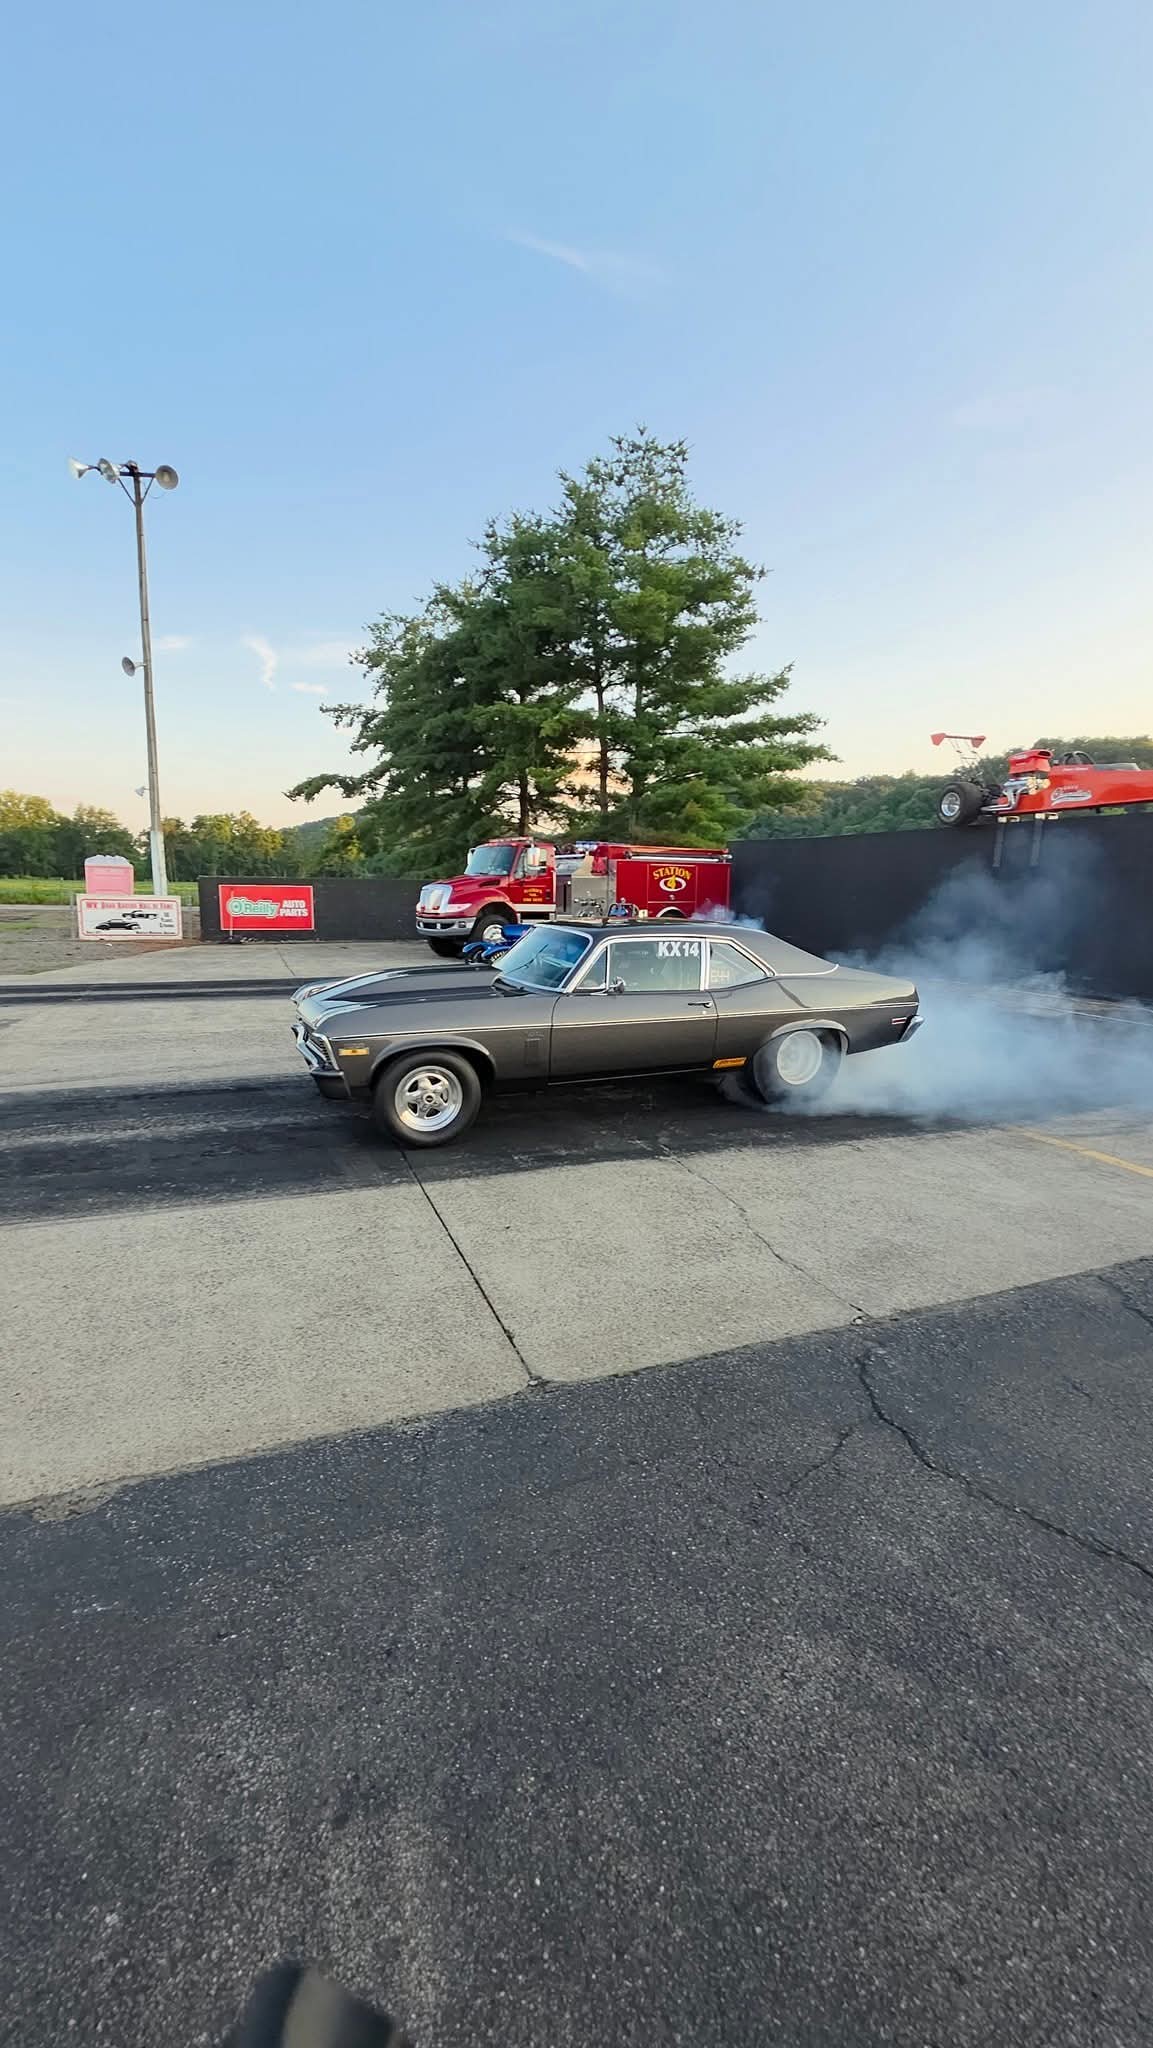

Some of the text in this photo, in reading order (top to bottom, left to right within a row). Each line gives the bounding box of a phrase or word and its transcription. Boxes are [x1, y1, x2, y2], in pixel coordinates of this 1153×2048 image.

[652, 866, 692, 880] STATION
[229, 898, 278, 917] O'Reilly
[282, 900, 306, 909] AUTO
[280, 908, 309, 917] PARTS
[658, 941, 699, 957] KX14
